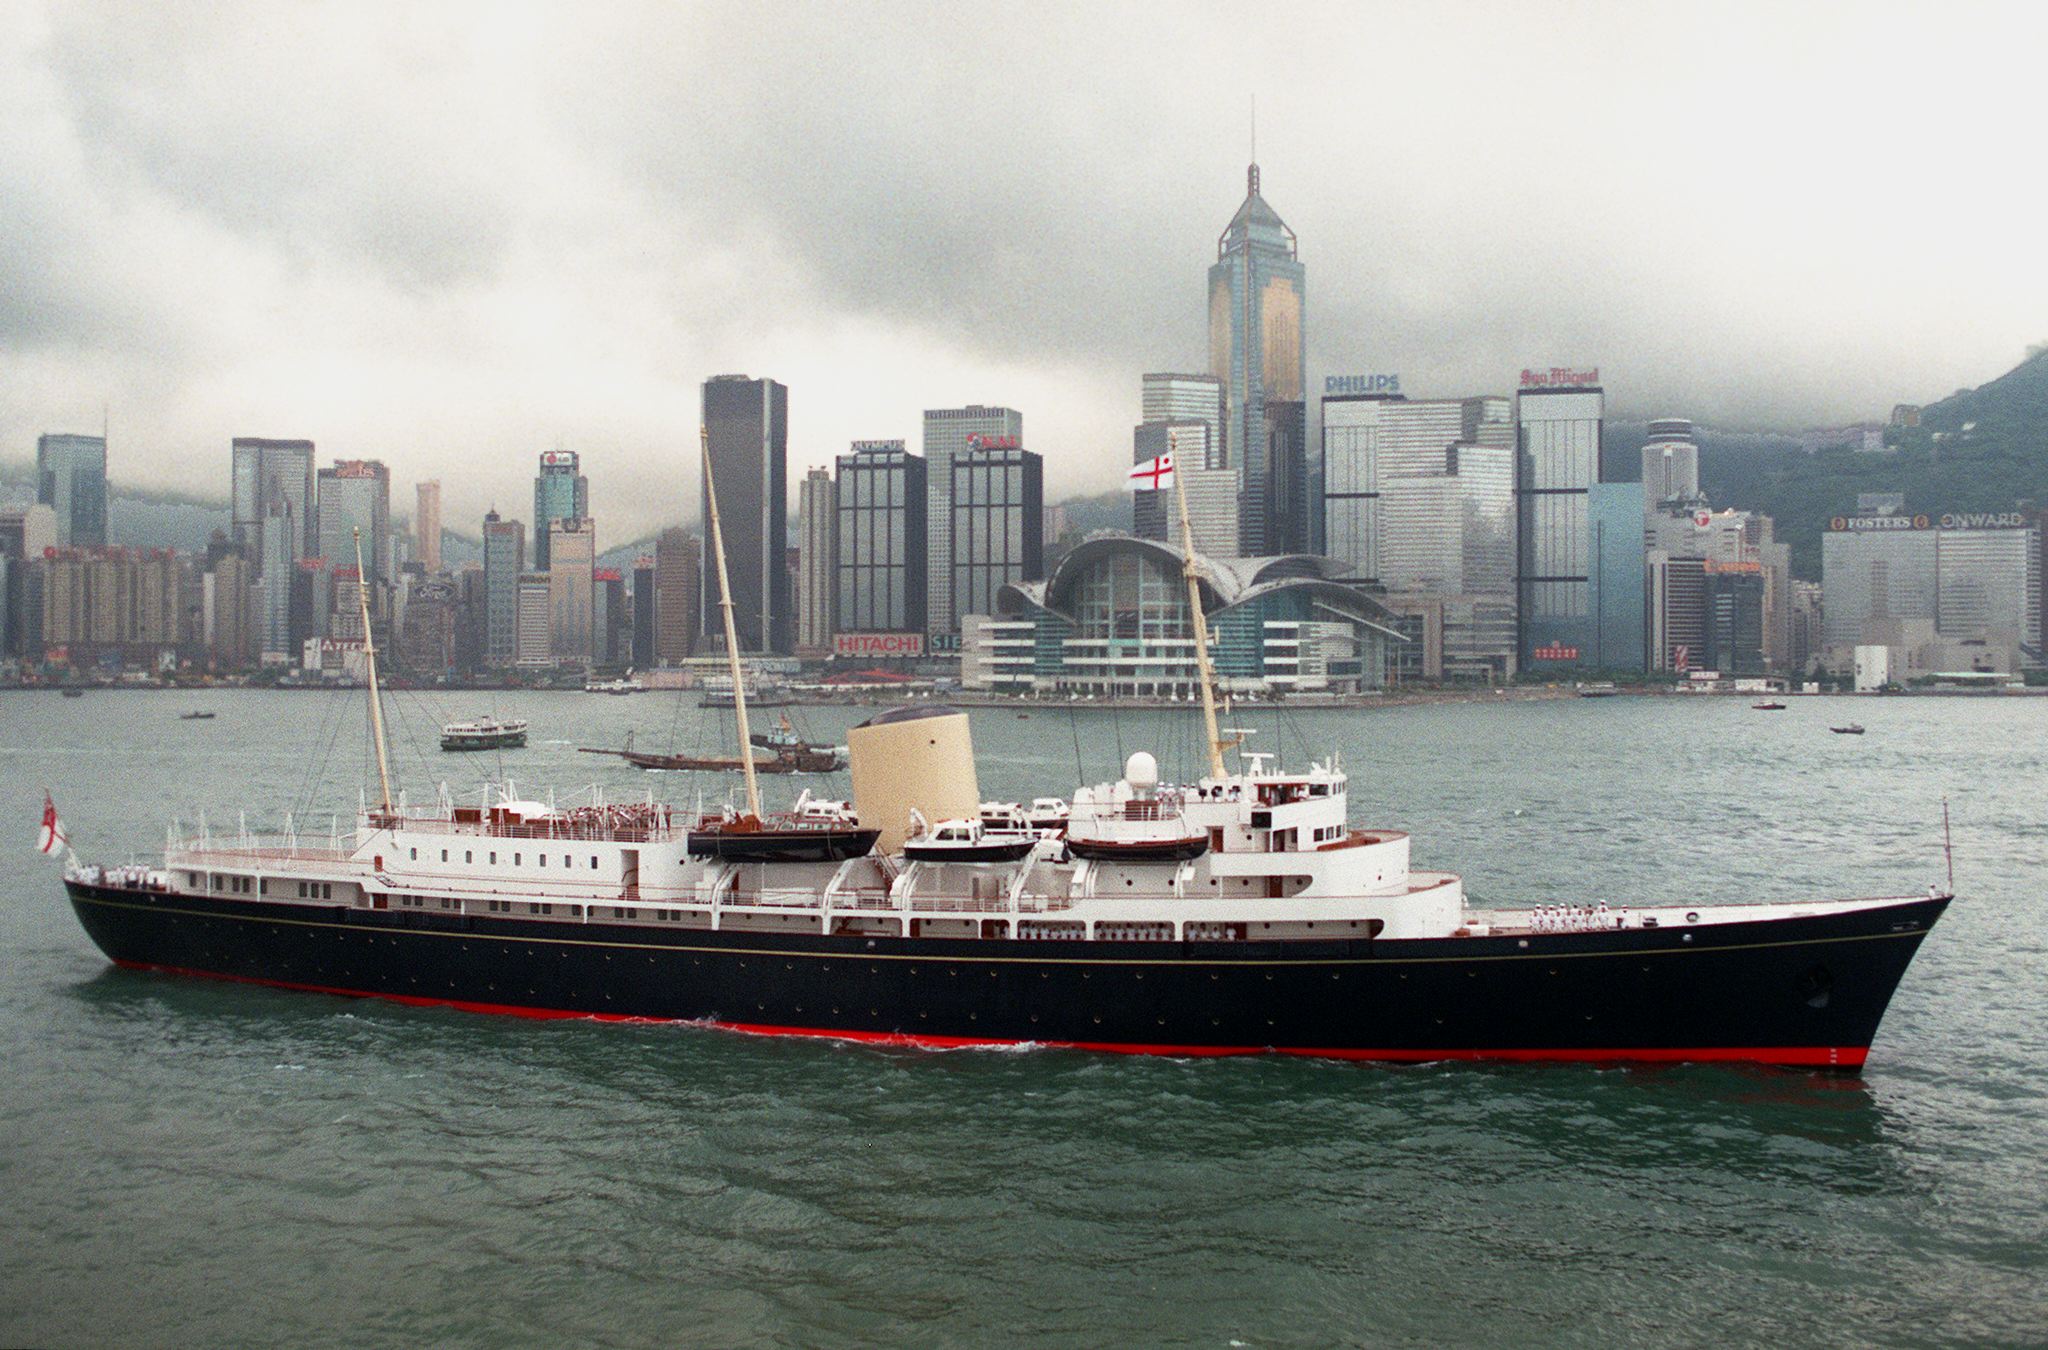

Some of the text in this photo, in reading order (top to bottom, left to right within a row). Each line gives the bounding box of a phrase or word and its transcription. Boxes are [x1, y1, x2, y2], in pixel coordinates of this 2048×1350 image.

[1325, 374, 1400, 392] PHILIPS
[1520, 367, 1599, 385] San Miguel
[1941, 512, 2023, 528] ONWARD
[838, 636, 919, 651] HITACHI
